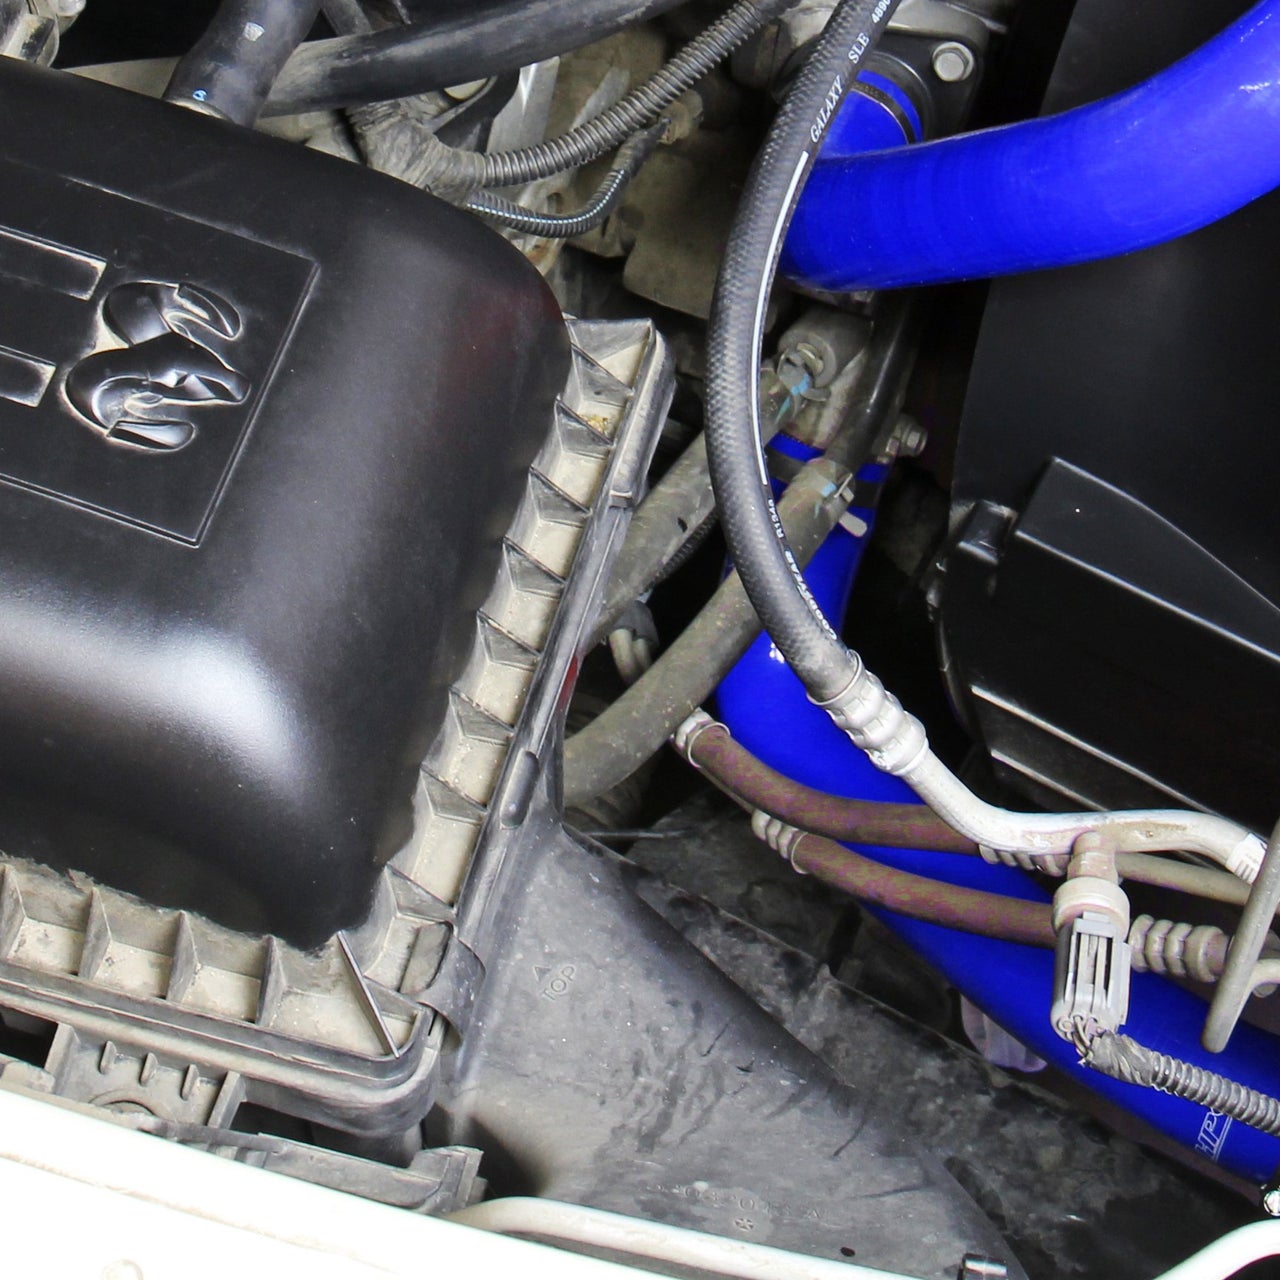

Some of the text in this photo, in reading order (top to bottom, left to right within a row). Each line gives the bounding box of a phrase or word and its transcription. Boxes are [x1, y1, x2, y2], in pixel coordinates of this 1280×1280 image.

[810, 74, 844, 143] GALAXY
[848, 32, 870, 64] SLE
[543, 964, 577, 1001] TOP
